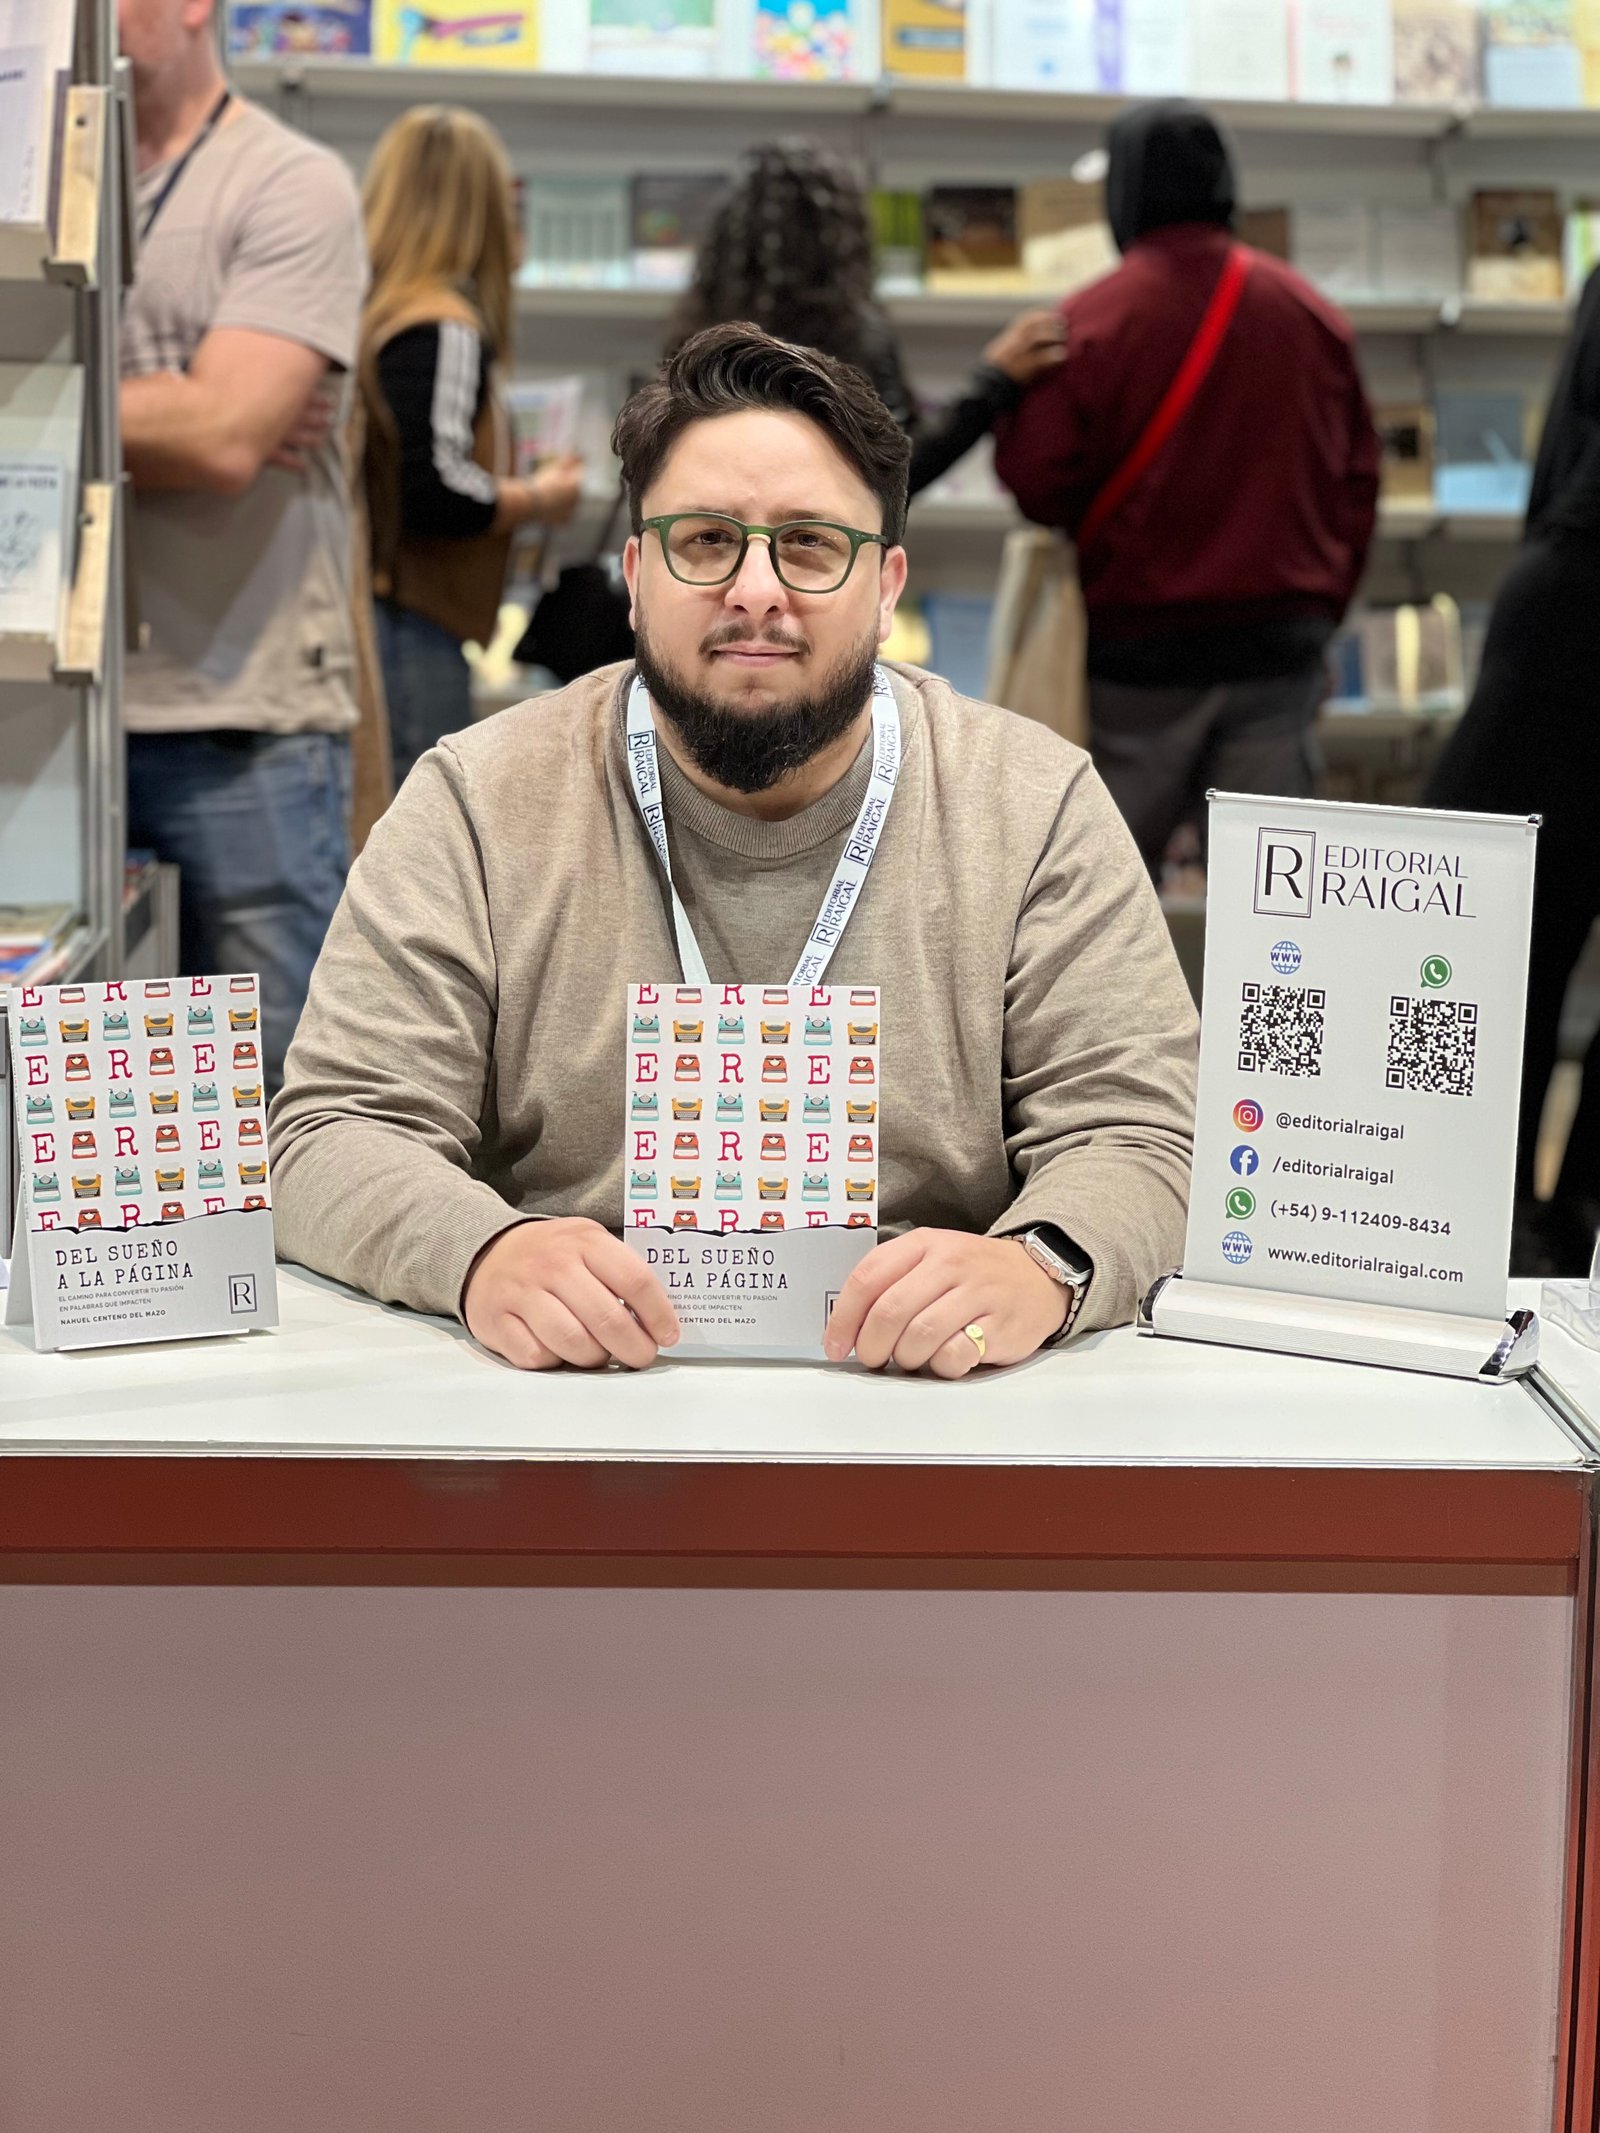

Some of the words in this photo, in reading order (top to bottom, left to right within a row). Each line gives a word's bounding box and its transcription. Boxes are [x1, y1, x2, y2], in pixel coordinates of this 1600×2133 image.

[634, 735, 650, 747] R
[879, 721, 887, 760] EDITORIAL
[885, 723, 897, 764] RAIGAL
[634, 750, 650, 799] RAIGAL
[645, 748, 657, 790] EDITORIAL
[877, 765, 893, 781] R
[647, 806, 659, 822] R
[856, 797, 877, 840] EDITORIAL
[862, 798, 887, 844] RAIGAL
[849, 845, 868, 862] R
[1324, 845, 1469, 878] EDITORIAL
[1264, 845, 1304, 899] R
[822, 879, 846, 923] EDITORIAL
[829, 880, 857, 927] RAIGAL
[1321, 871, 1477, 918] RAIGAL
[817, 929, 834, 944] R
[792, 955, 814, 986] ITORIAL
[105, 981, 128, 1002] R
[720, 984, 745, 1005] R
[27, 1055, 50, 1086] E
[108, 1049, 133, 1080] R
[193, 1043, 216, 1074] E
[635, 1052, 659, 1083] E
[719, 1053, 744, 1084] R
[807, 1054, 831, 1085] E
[1276, 1112, 1404, 1141] @editorialraigal
[32, 1132, 56, 1164] E
[114, 1125, 140, 1158] R
[198, 1119, 221, 1151] E
[634, 1130, 657, 1161] E
[718, 1131, 743, 1162] R
[806, 1132, 830, 1163] E
[1272, 1156, 1394, 1185] /editorialraigal
[120, 1203, 142, 1227] R
[719, 1209, 741, 1232] R
[1270, 1200, 1317, 1222] (+54)
[1322, 1206, 1451, 1236] 9-112409-8434
[55, 1247, 98, 1266] DEL
[108, 1239, 178, 1262] SUEÑO
[647, 1248, 690, 1265] DEL
[701, 1246, 775, 1266] SUEÑO
[1268, 1247, 1463, 1282] www.editorialraigal.com
[57, 1274, 68, 1290] A
[79, 1270, 104, 1288] LA
[115, 1262, 194, 1284] PÁGINA
[669, 1271, 694, 1288] LA
[706, 1268, 788, 1289] PÁGINA
[67, 1293, 94, 1301] CAMINO
[95, 1291, 112, 1299] PARA
[112, 1288, 149, 1297] CONVERTIR
[160, 1284, 184, 1292] PASIÓN
[70, 1302, 103, 1312] PALABRAS
[104, 1301, 118, 1309] QUE
[118, 1298, 151, 1308] IMPACTEN
[233, 1281, 252, 1306] R
[752, 1293, 778, 1301] PASIÓN
[60, 1317, 91, 1326] NAHUEL
[93, 1313, 127, 1322] CENTENO
[145, 1310, 166, 1318] MAZO
